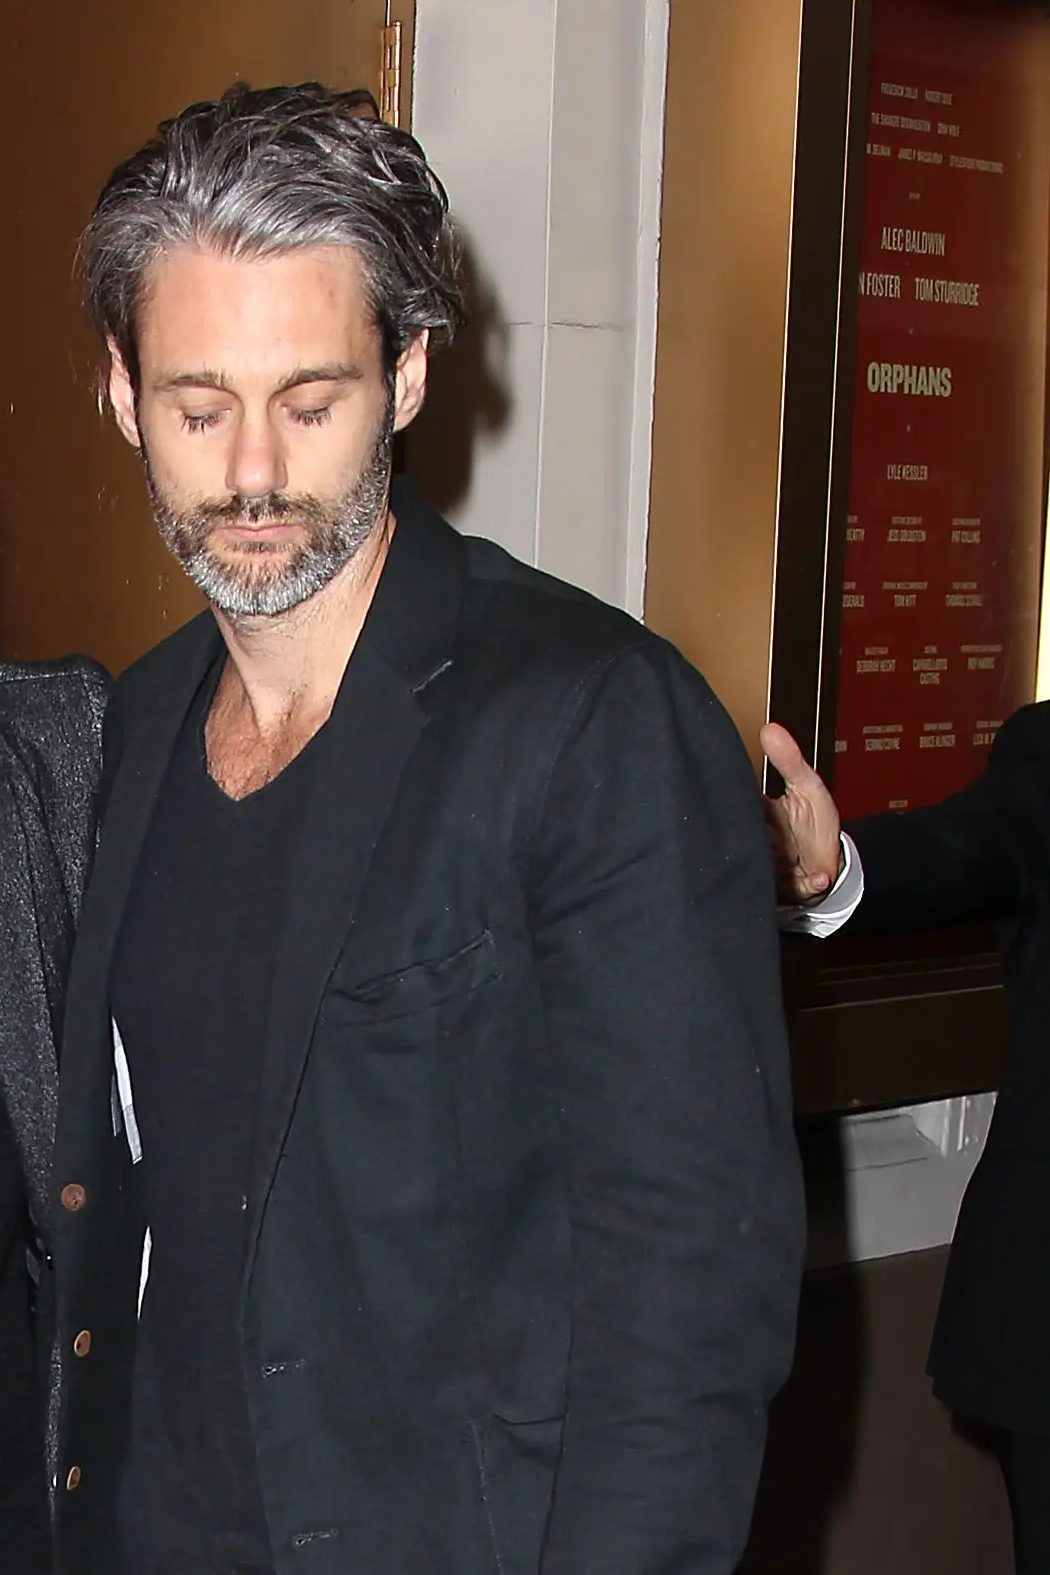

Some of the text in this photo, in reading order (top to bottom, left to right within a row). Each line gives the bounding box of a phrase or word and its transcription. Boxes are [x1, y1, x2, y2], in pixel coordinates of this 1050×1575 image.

[880, 226, 946, 257] ALEC BALDWIN
[866, 272, 901, 299] FOSTER
[914, 277, 980, 306] TOM STURRIDGE
[867, 361, 952, 398] ORPHANS
